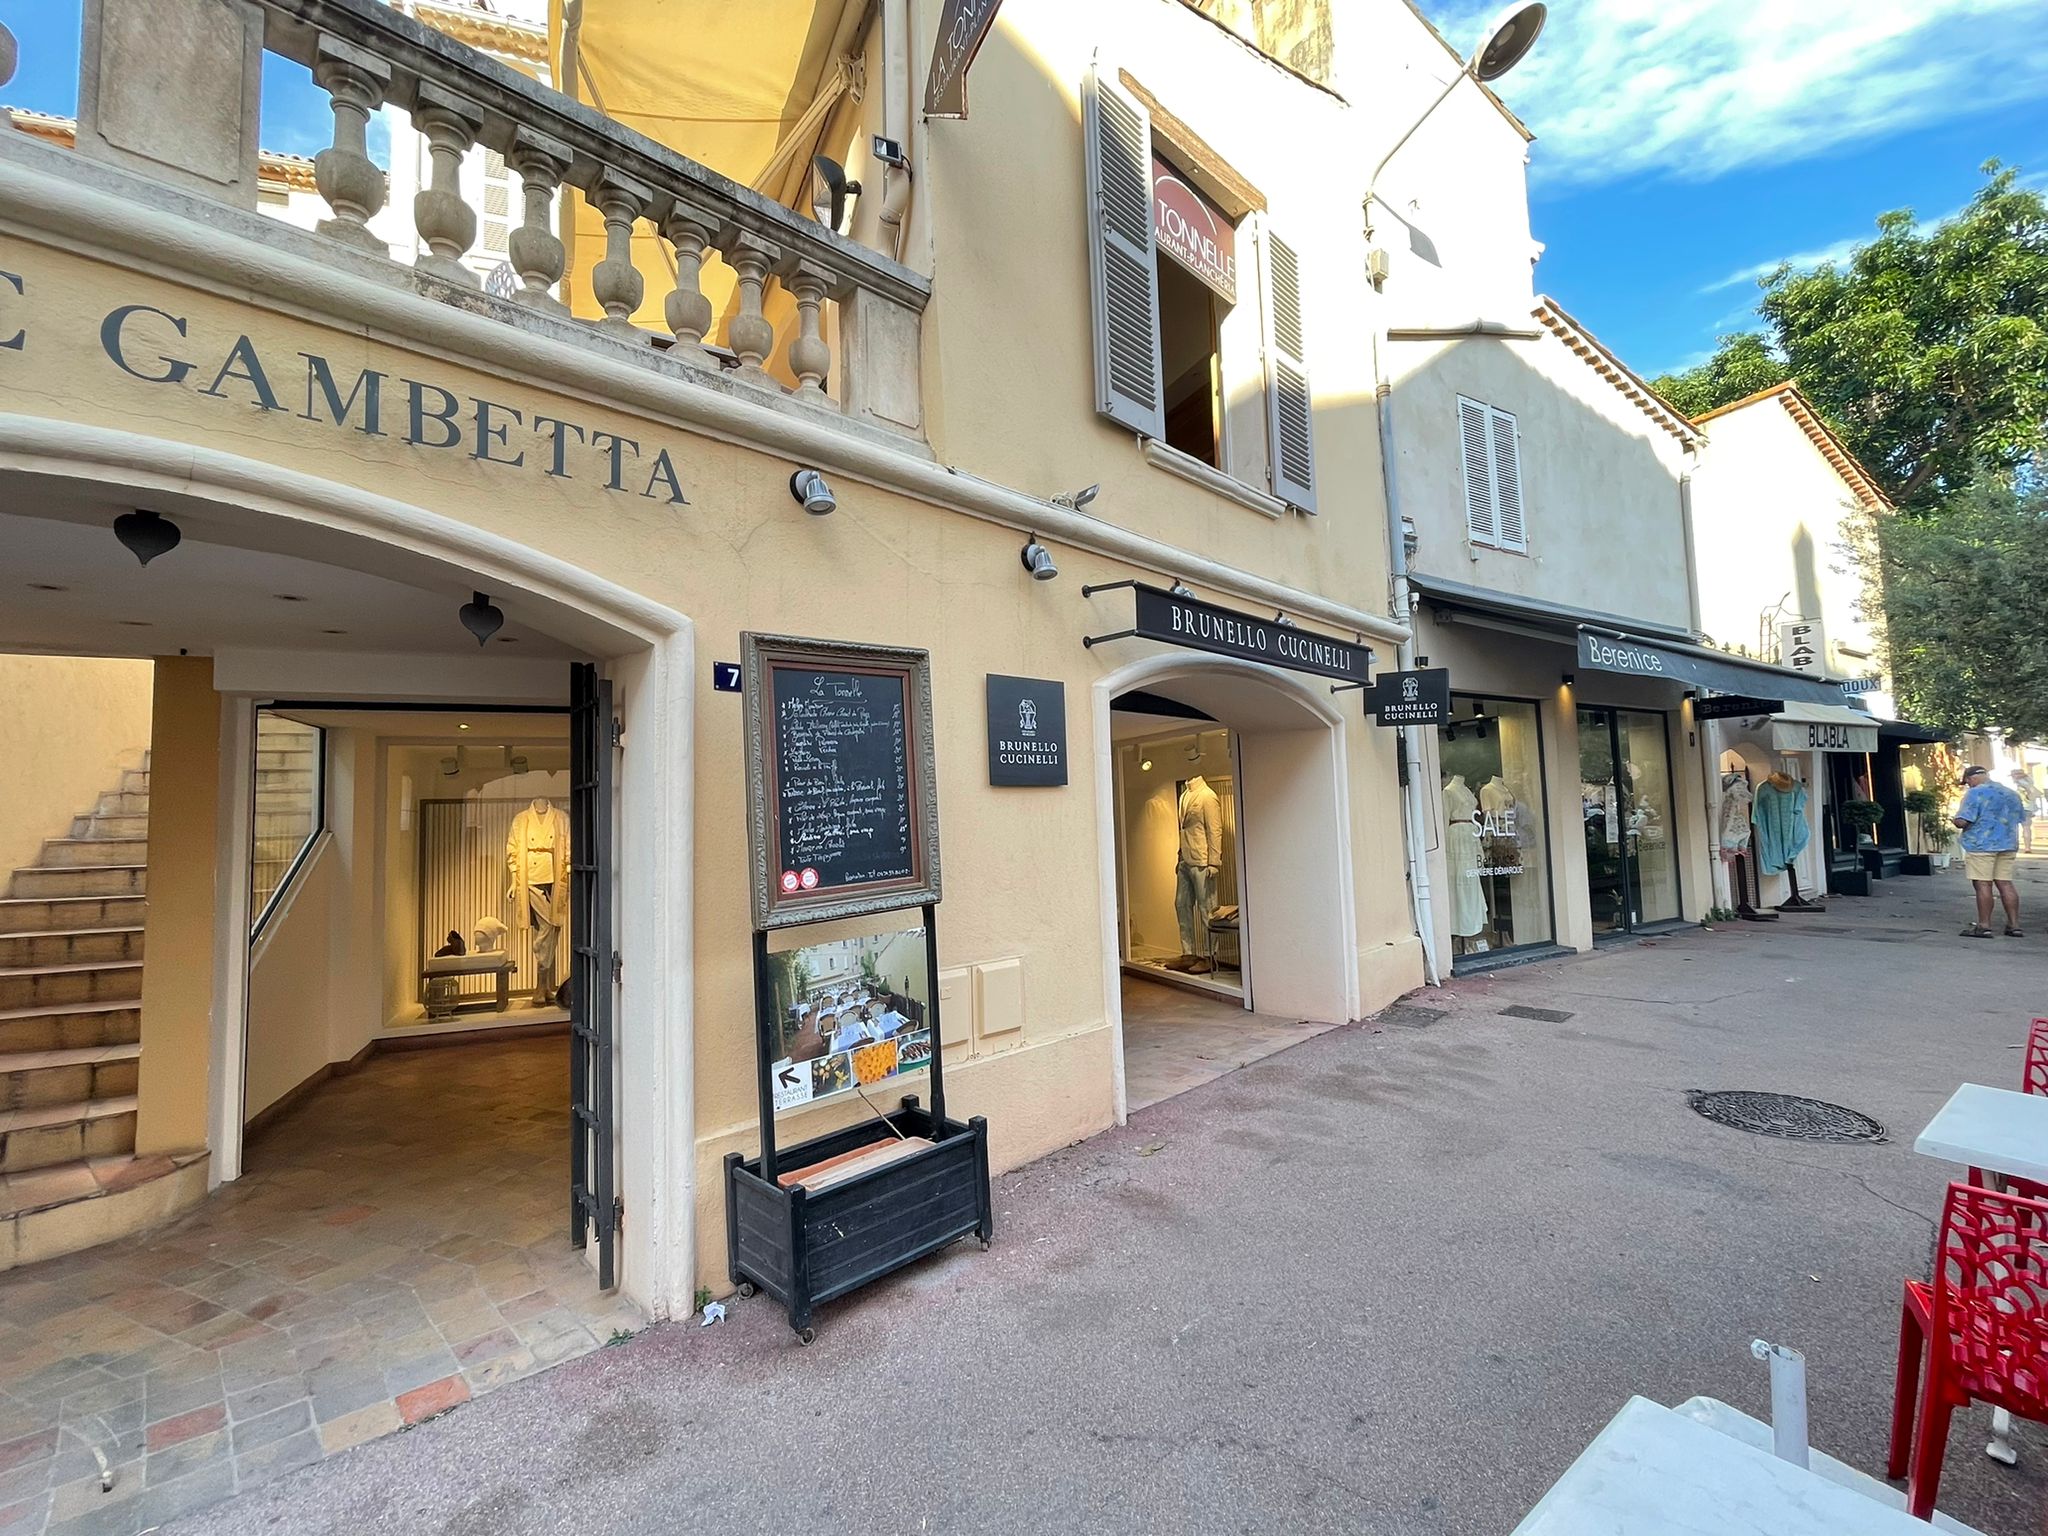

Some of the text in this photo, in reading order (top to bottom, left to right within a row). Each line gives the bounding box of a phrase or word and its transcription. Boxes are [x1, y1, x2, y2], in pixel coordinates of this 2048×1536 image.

[932, 57, 946, 95] LA
[1158, 199, 1235, 283] TONNELLE
[100, 304, 691, 505] GAMBETTA
[1171, 605, 1351, 671] BRUNELLO CUCINELLI
[1790, 625, 1816, 671] BLAB
[1588, 635, 1663, 672] Berenice
[727, 668, 739, 687] 7
[1384, 702, 1438, 712] BRUNELLO
[1384, 710, 1438, 720] CUCINELLI
[1000, 740, 1058, 752] BRUNELLO
[1809, 724, 1850, 748] BLABLA
[1000, 753, 1058, 765] CUCINELLI
[1472, 809, 1516, 838] SALE
